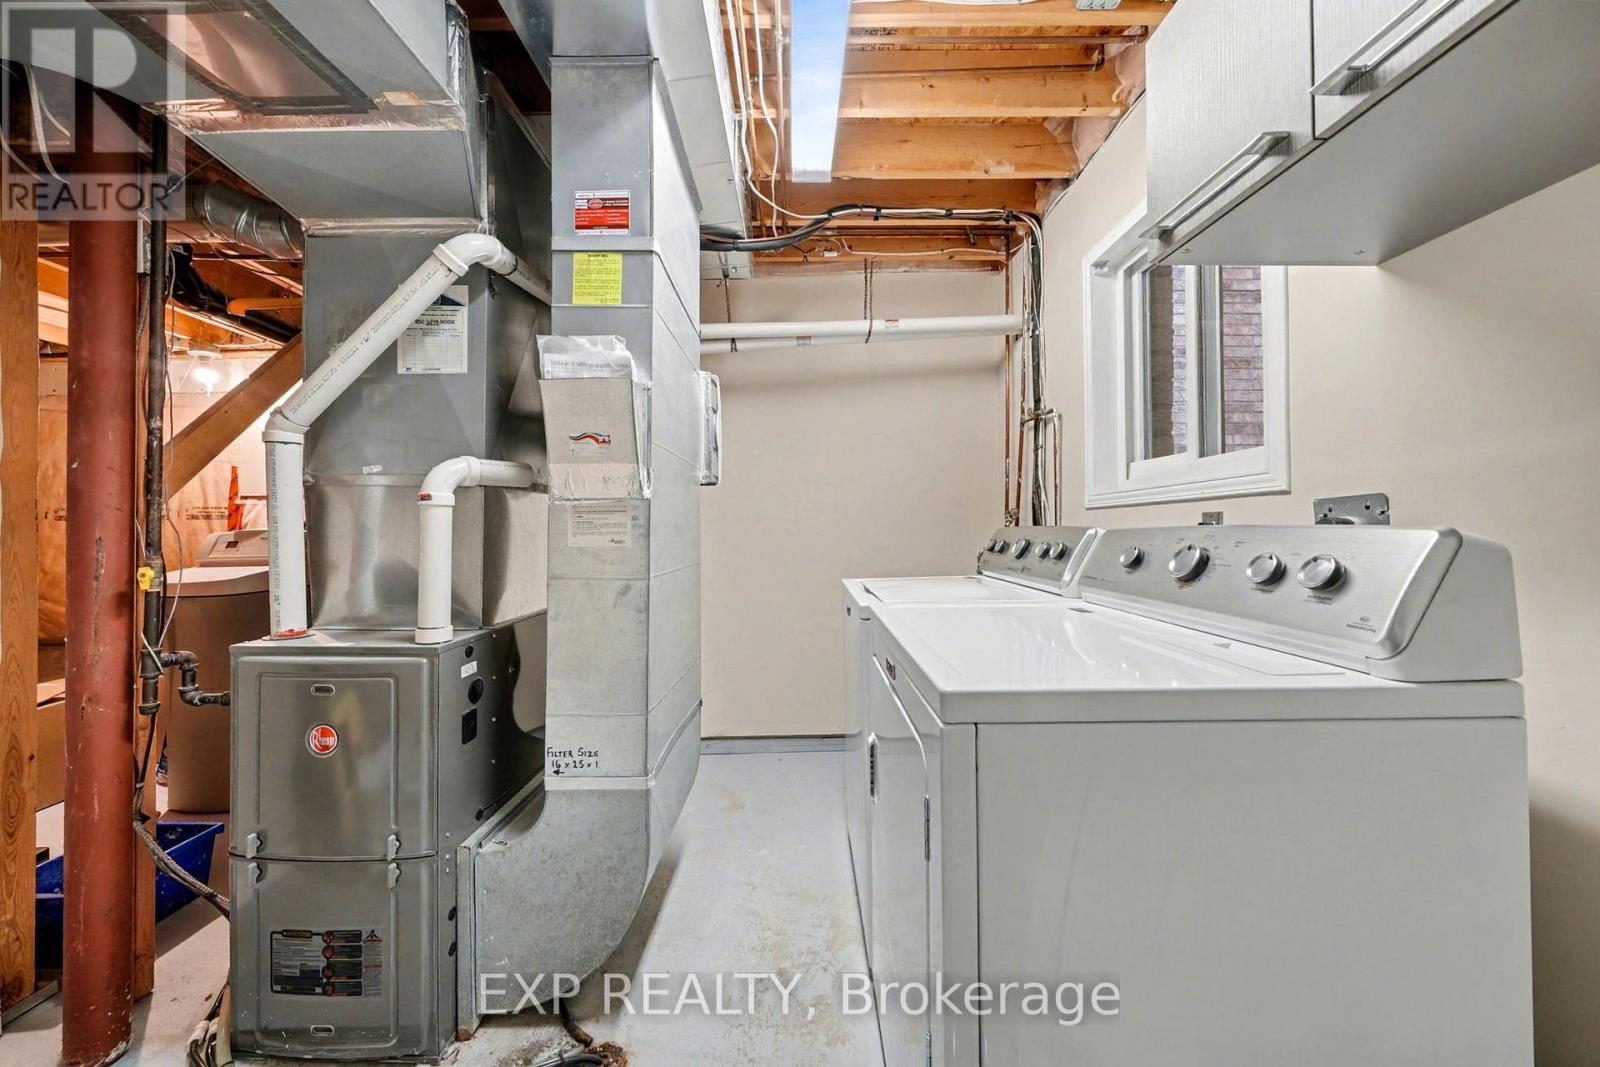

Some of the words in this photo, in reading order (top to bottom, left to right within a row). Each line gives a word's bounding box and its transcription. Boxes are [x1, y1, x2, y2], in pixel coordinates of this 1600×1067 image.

[546, 747, 574, 758] FILTER
[551, 760, 562, 769] 16
[572, 759, 584, 769] 25
